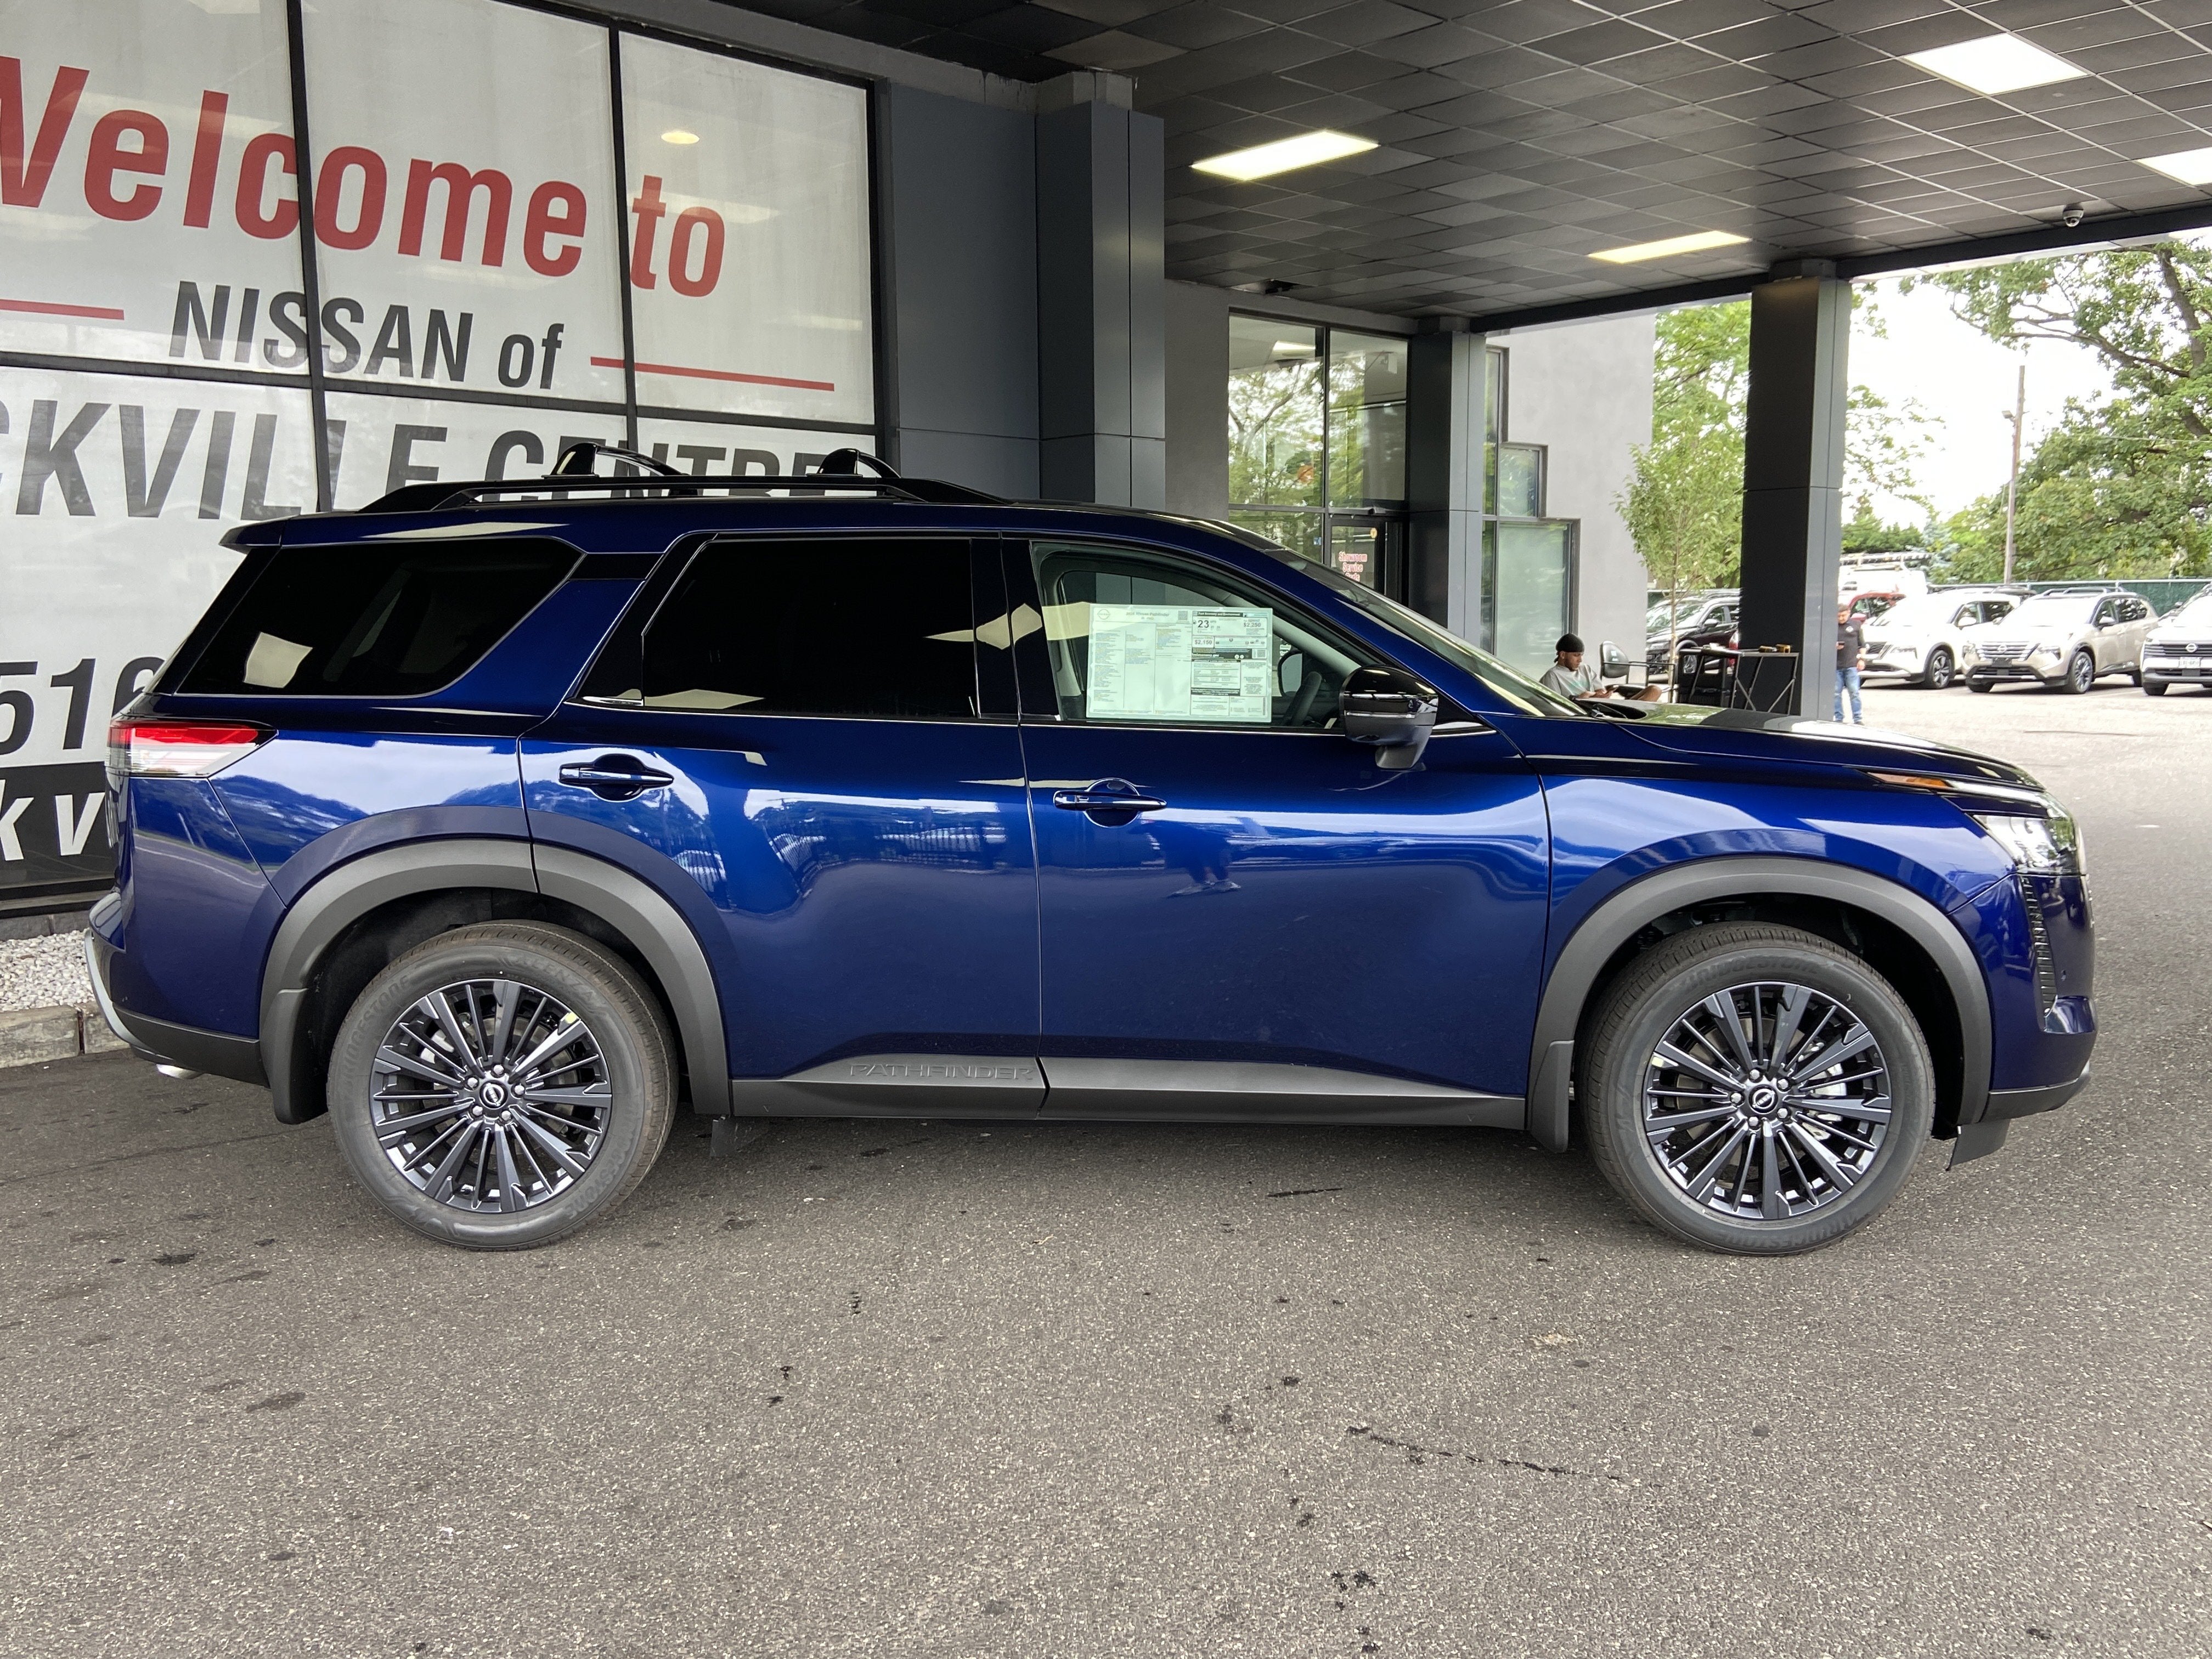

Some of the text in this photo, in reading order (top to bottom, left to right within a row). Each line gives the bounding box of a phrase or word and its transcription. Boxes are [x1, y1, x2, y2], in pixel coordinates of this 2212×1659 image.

[630, 175, 725, 297] to
[169, 281, 565, 390] NISSAN of
[0, 399, 448, 521] KVILLE
[1339, 551, 1368, 562] Showroom
[1342, 562, 1363, 573] Service
[1198, 620, 1209, 628] 23
[850, 1063, 1034, 1080] PATHFINDER
